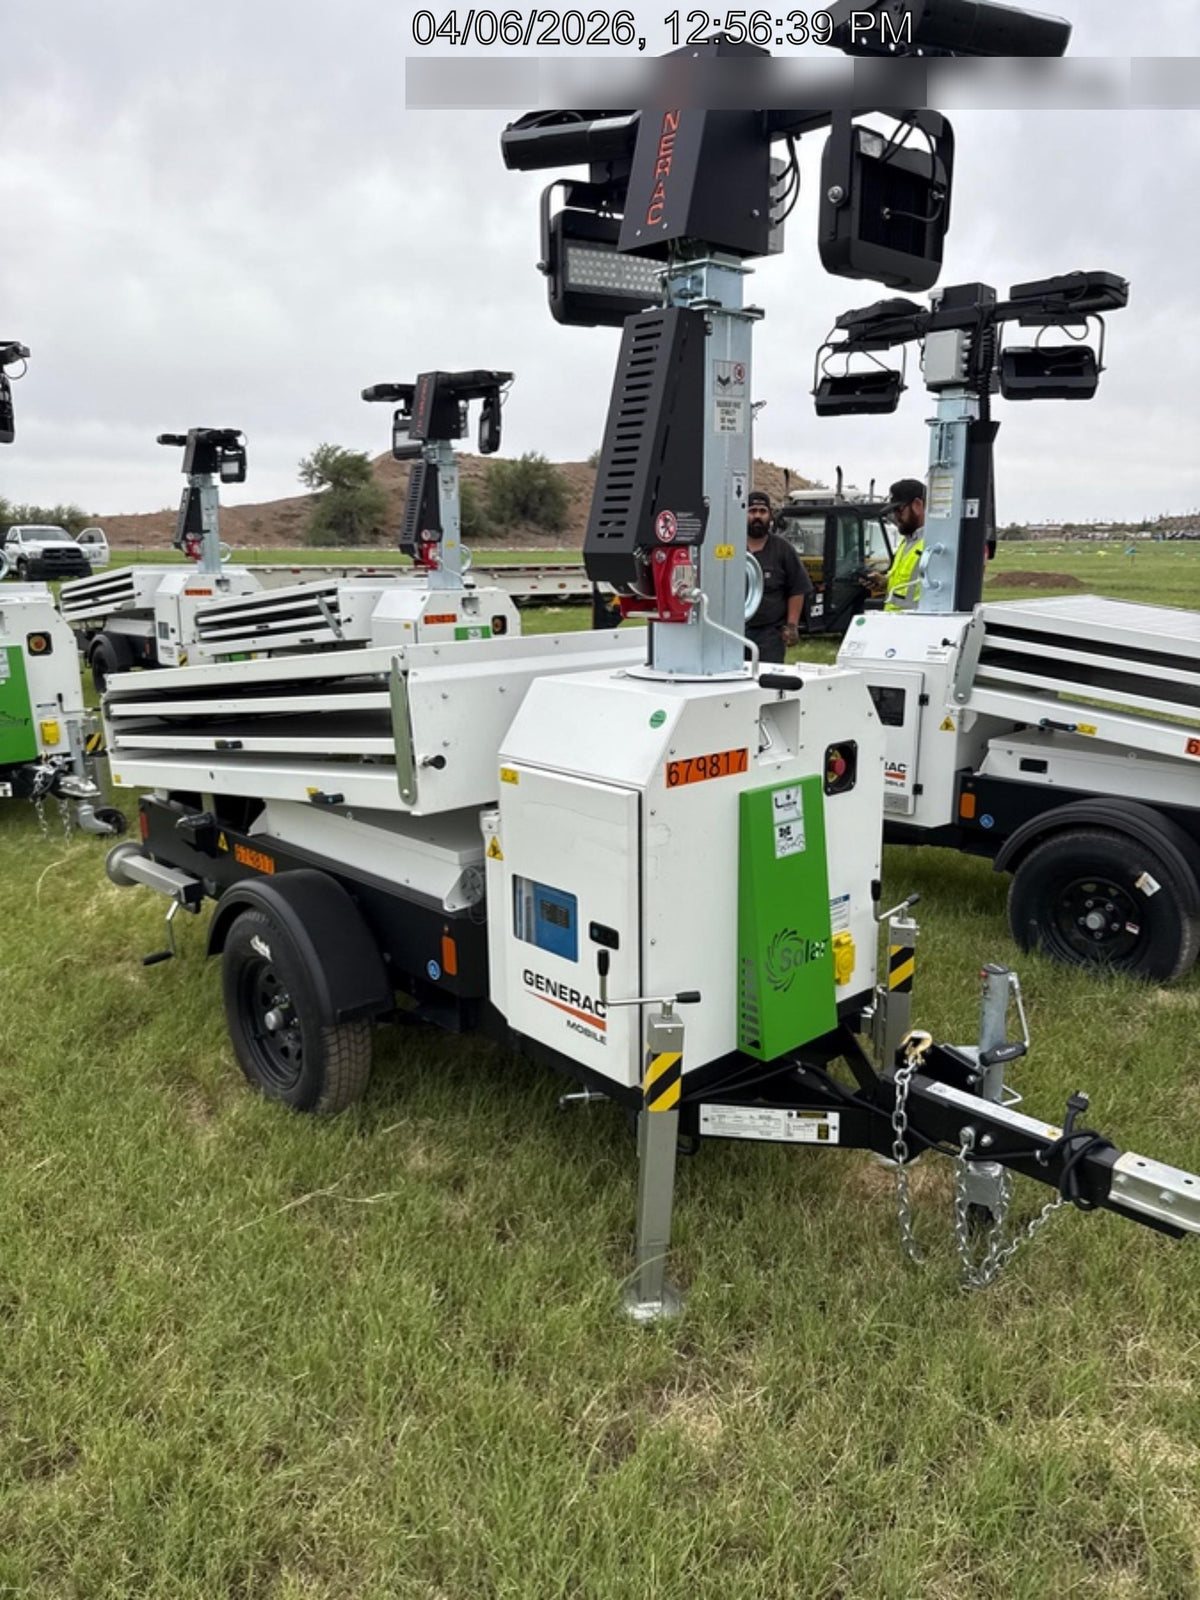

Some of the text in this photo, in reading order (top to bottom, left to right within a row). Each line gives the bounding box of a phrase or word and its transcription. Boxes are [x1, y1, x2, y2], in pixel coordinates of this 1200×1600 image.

[646, 109, 681, 225] NERAC
[667, 747, 748, 787] 679817
[780, 938, 829, 972] Solar
[523, 968, 607, 1019] GENERAC
[566, 1019, 607, 1046] MOBILE
